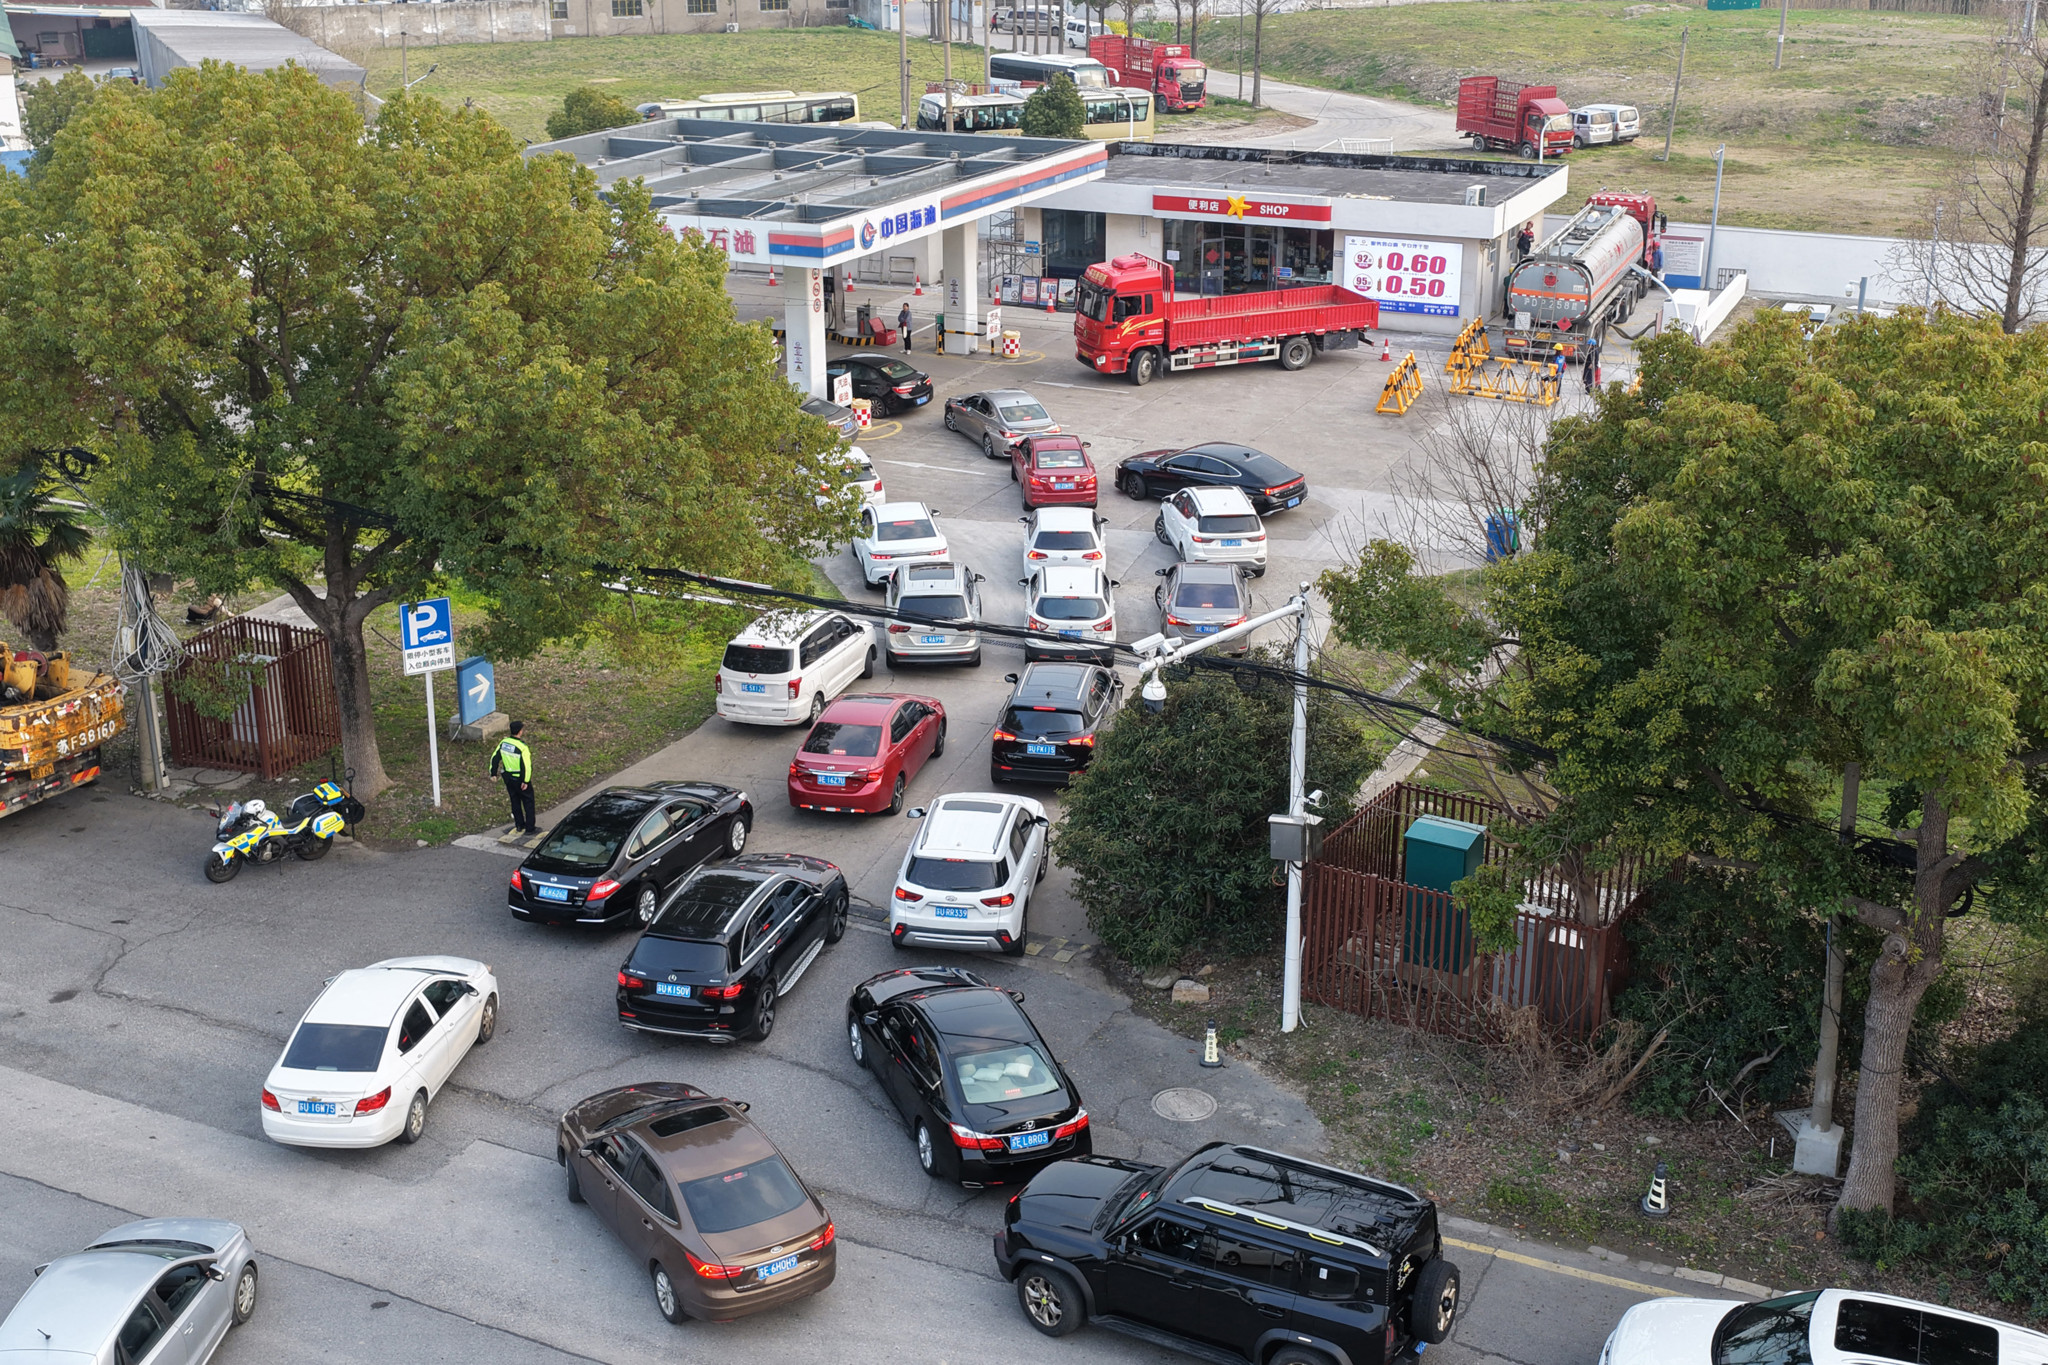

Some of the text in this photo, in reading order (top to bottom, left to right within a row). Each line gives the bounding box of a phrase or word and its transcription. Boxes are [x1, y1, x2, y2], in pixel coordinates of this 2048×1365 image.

[1187, 199, 1219, 212] 便利店
[1259, 204, 1289, 216] SHOP
[881, 204, 936, 239] 中国海油
[1386, 252, 1447, 275] 0.60
[1385, 275, 1446, 298] 0.50
[407, 604, 438, 647] P
[406, 646, 450, 660] 限停小型客车
[407, 656, 452, 671] 入位顺向停放
[56, 719, 116, 756] 苏F38160
